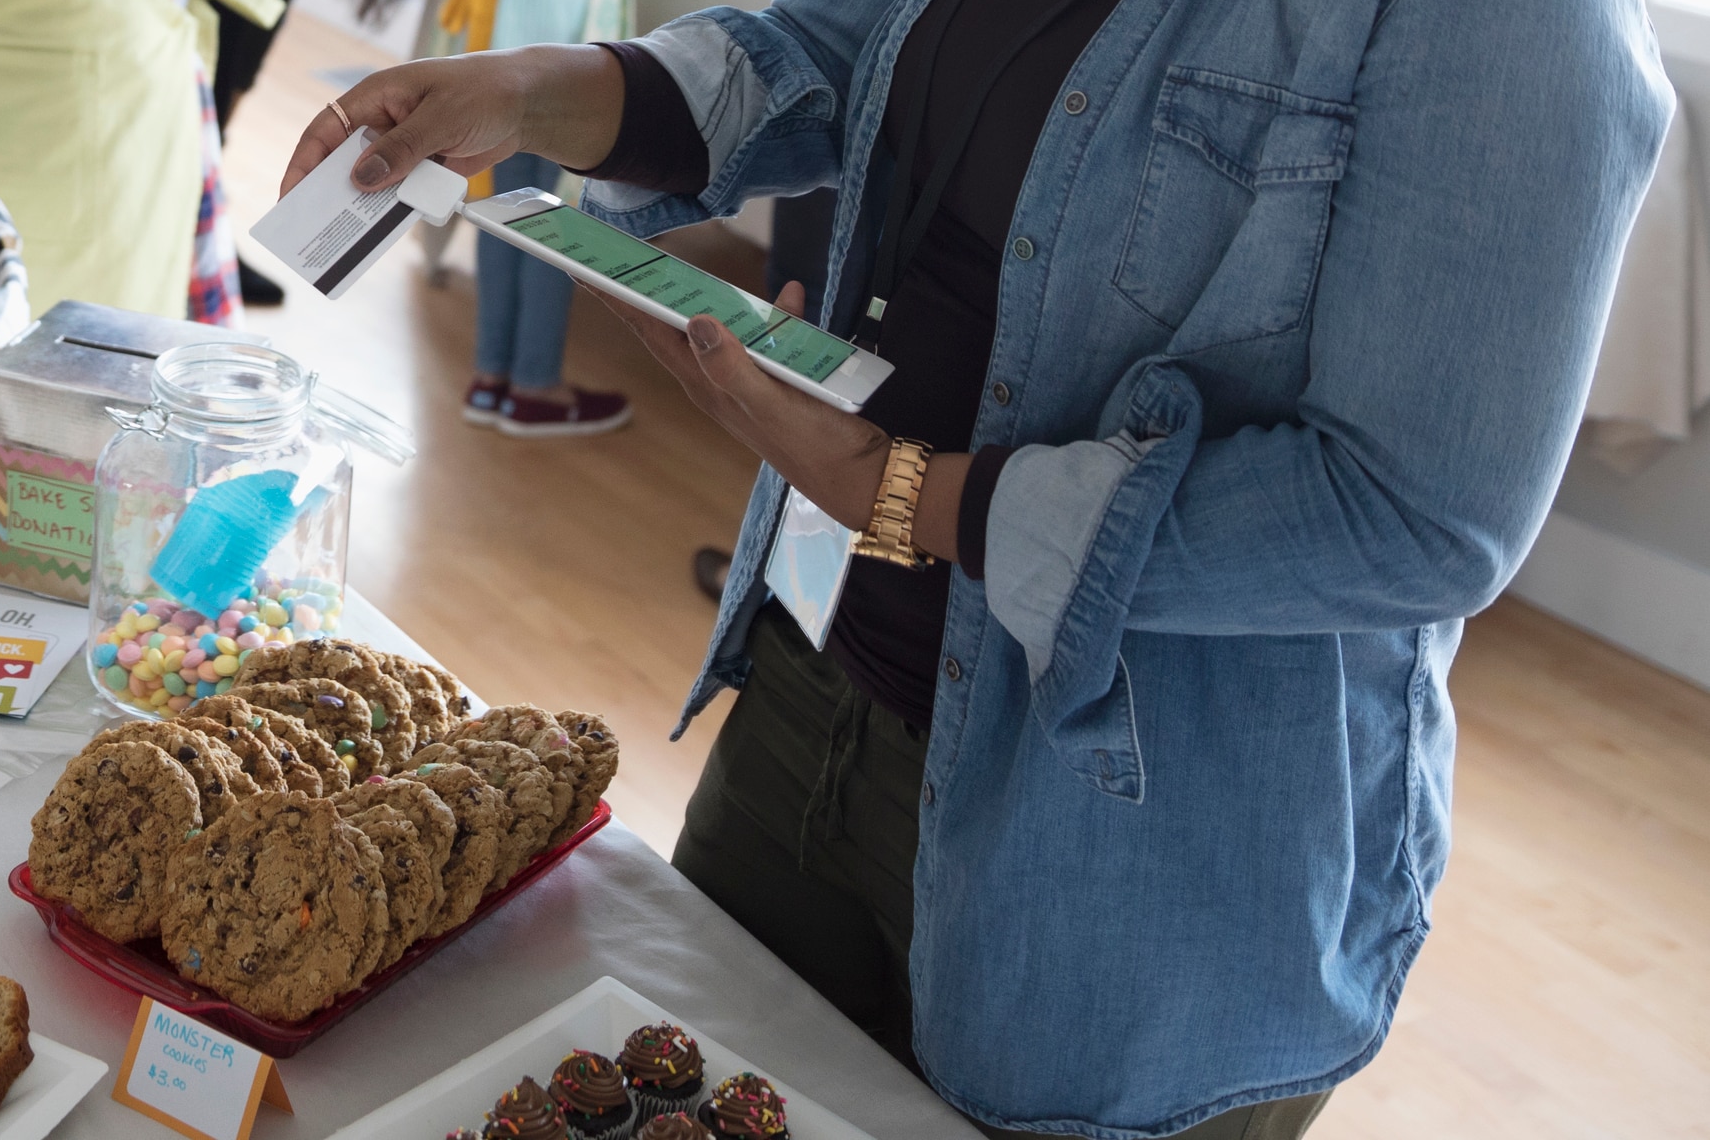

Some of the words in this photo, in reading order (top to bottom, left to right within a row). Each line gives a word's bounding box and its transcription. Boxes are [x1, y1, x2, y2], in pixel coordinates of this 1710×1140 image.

[18, 482, 66, 510] BAKE
[153, 1012, 235, 1068] MONSTER
[148, 1063, 186, 1091] $3.00
